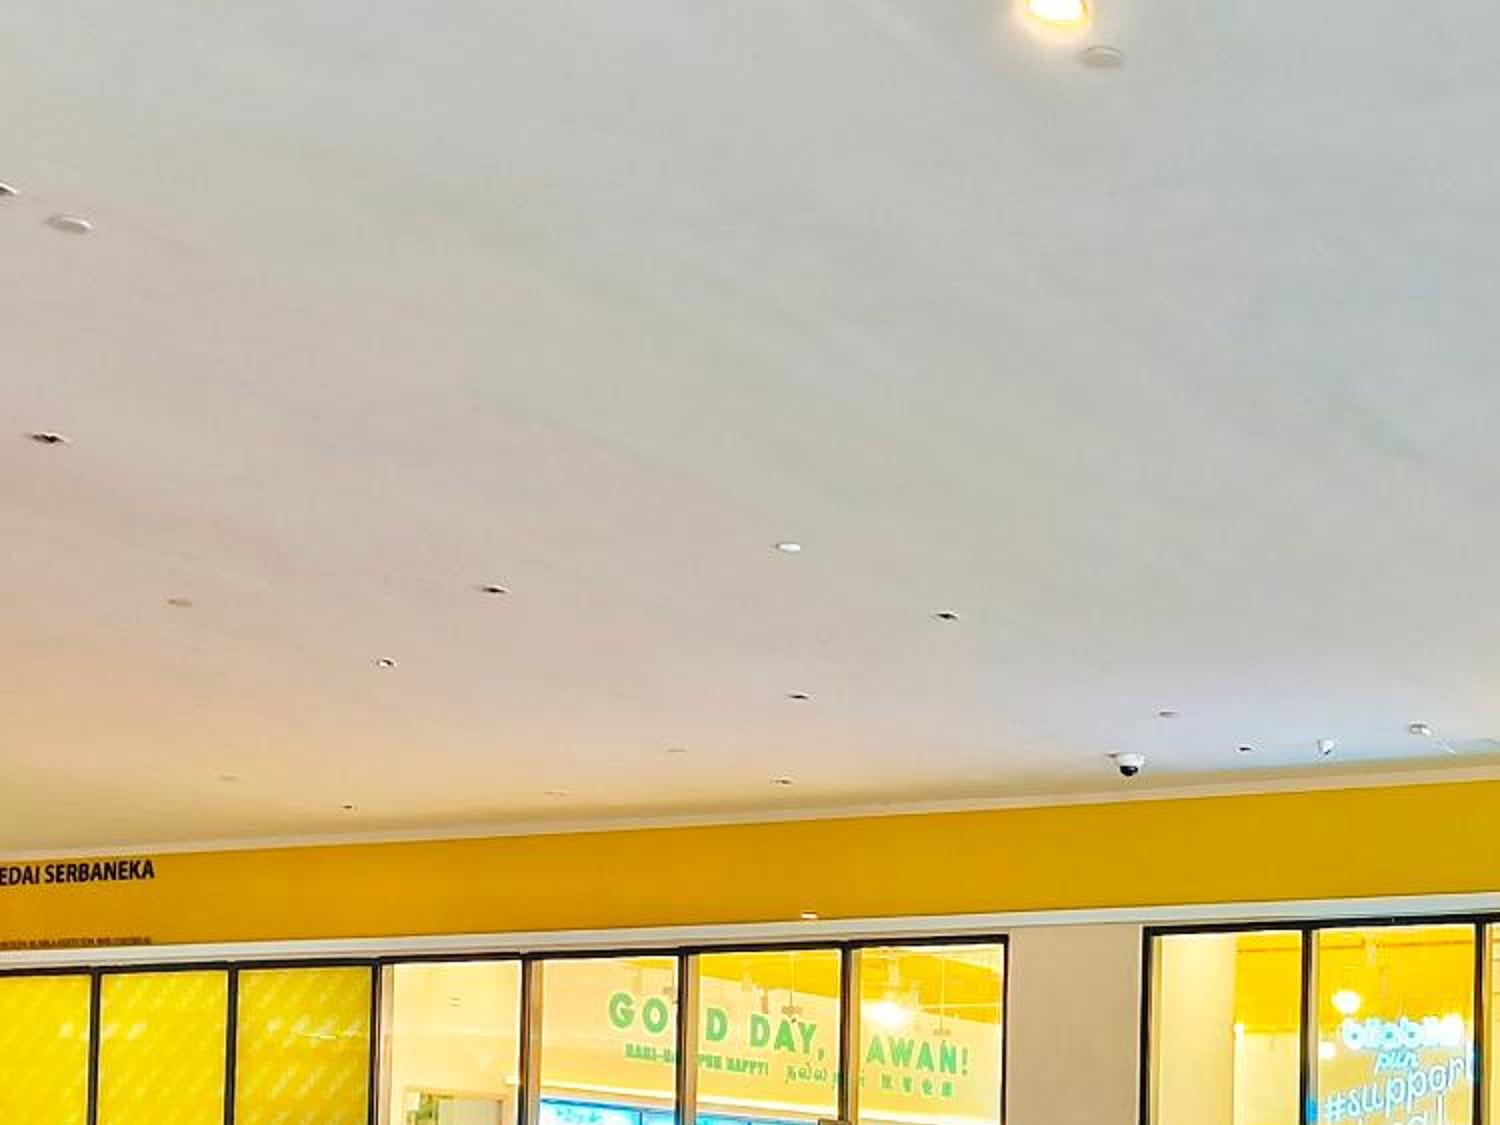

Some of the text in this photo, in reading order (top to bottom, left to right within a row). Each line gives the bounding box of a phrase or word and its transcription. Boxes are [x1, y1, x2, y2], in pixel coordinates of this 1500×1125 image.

[45, 859, 156, 884] SERBANEKA
[608, 991, 727, 1043] GOD
[864, 1033, 969, 1078] AWAN!
